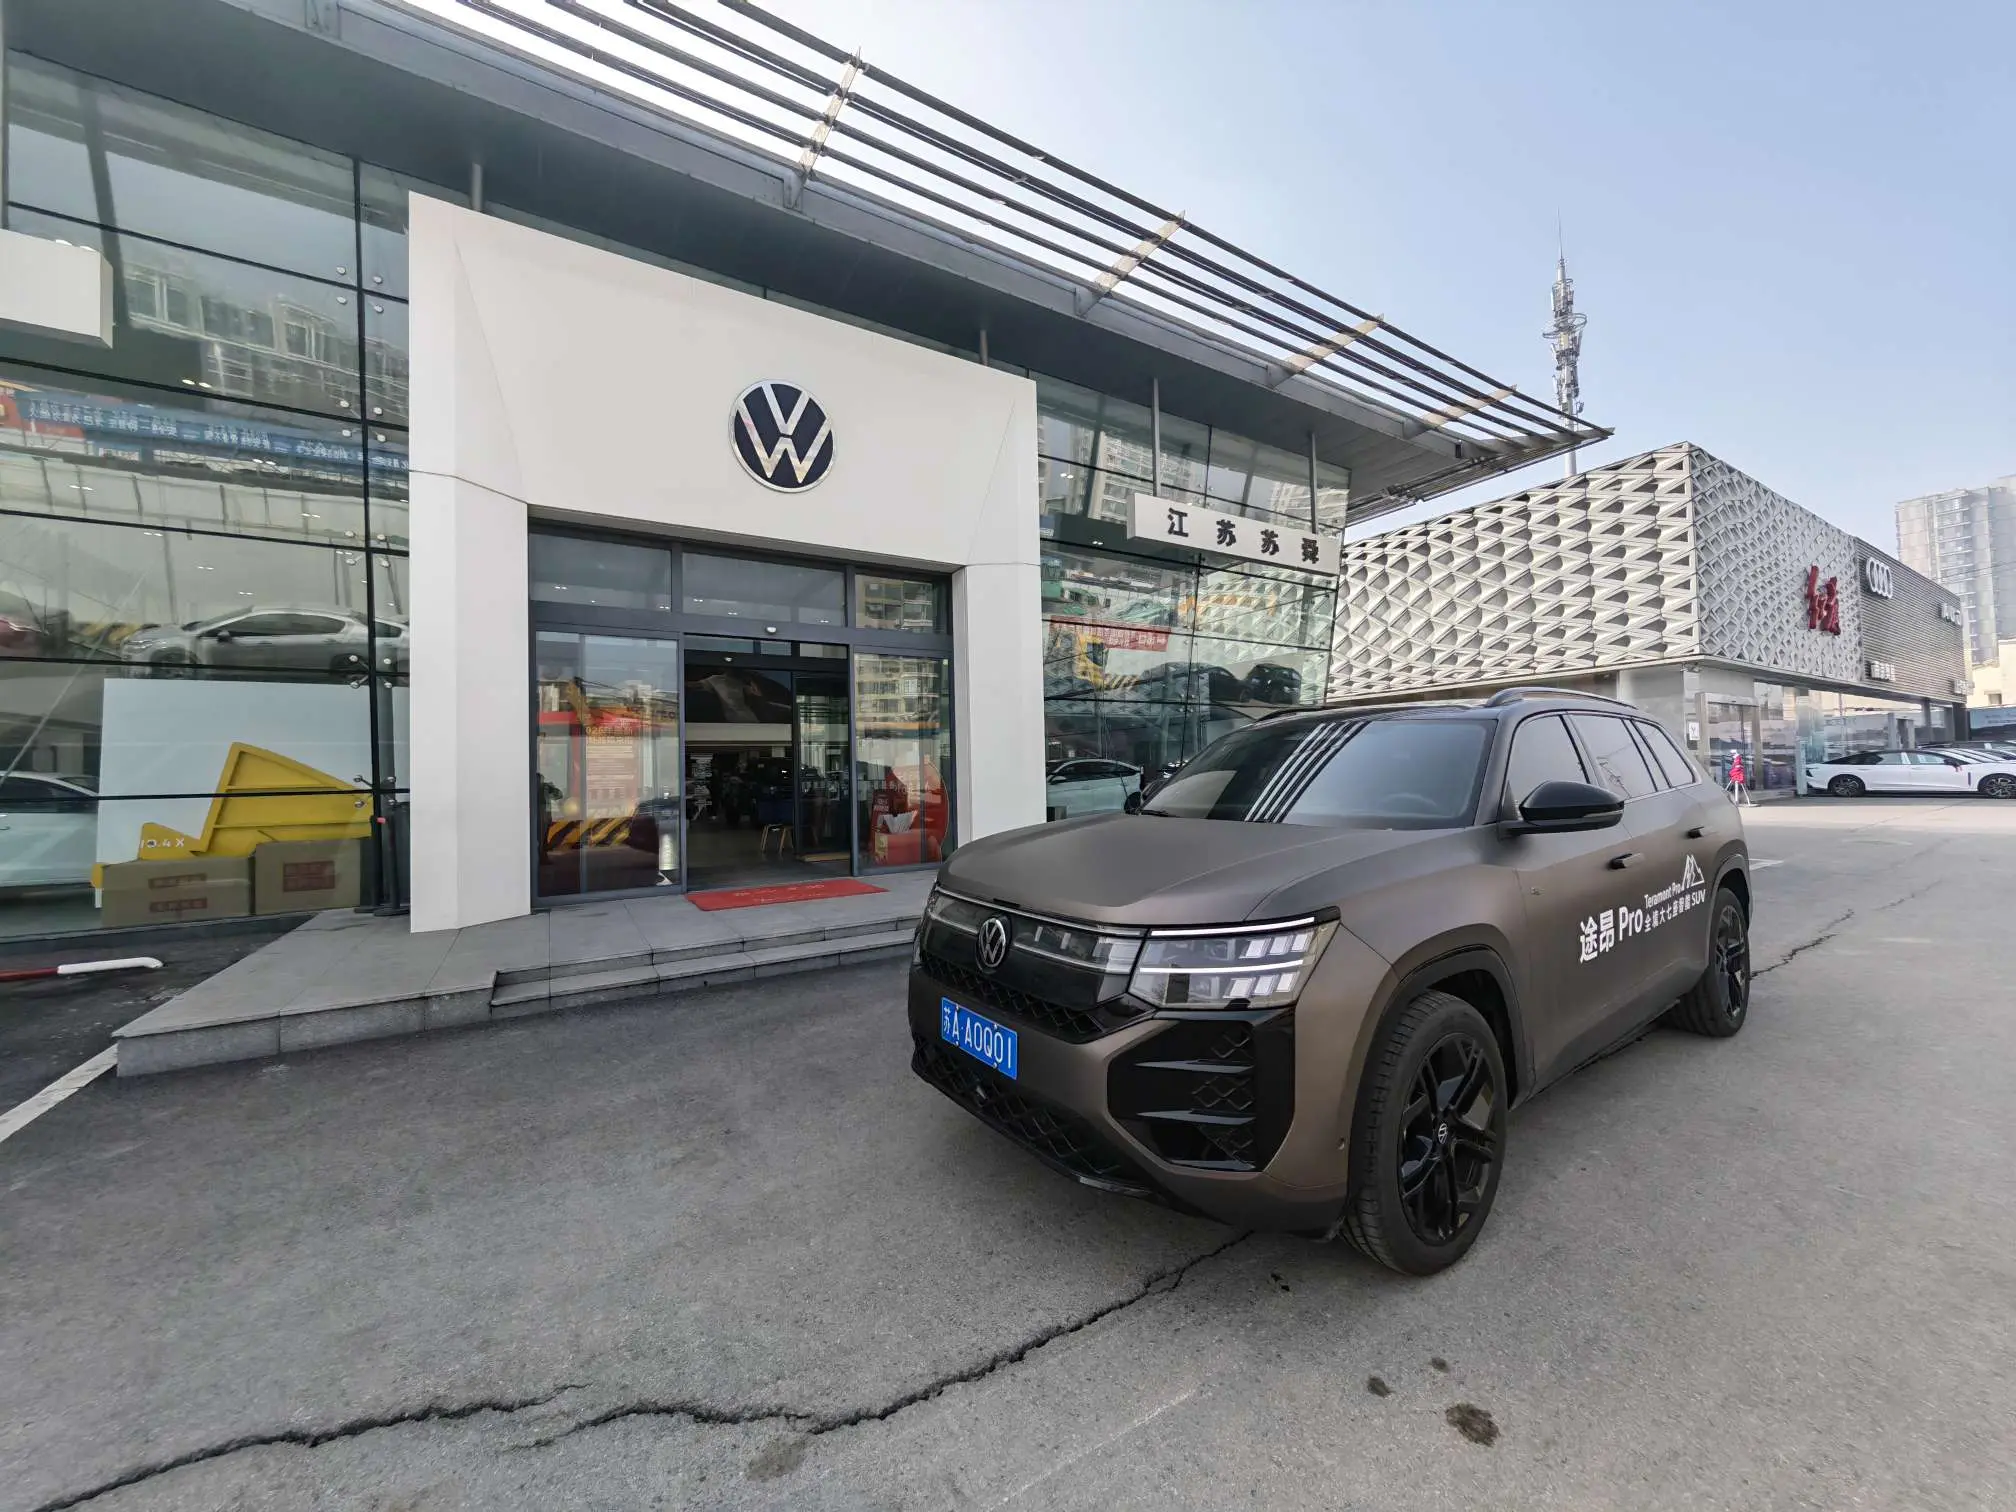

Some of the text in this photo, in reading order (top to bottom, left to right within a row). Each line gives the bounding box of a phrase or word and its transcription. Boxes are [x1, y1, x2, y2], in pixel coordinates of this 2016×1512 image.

[1643, 887, 1672, 909] Teramont
[1691, 889, 1706, 907] SUV
[1579, 906, 1644, 964] 途昂 Pro
